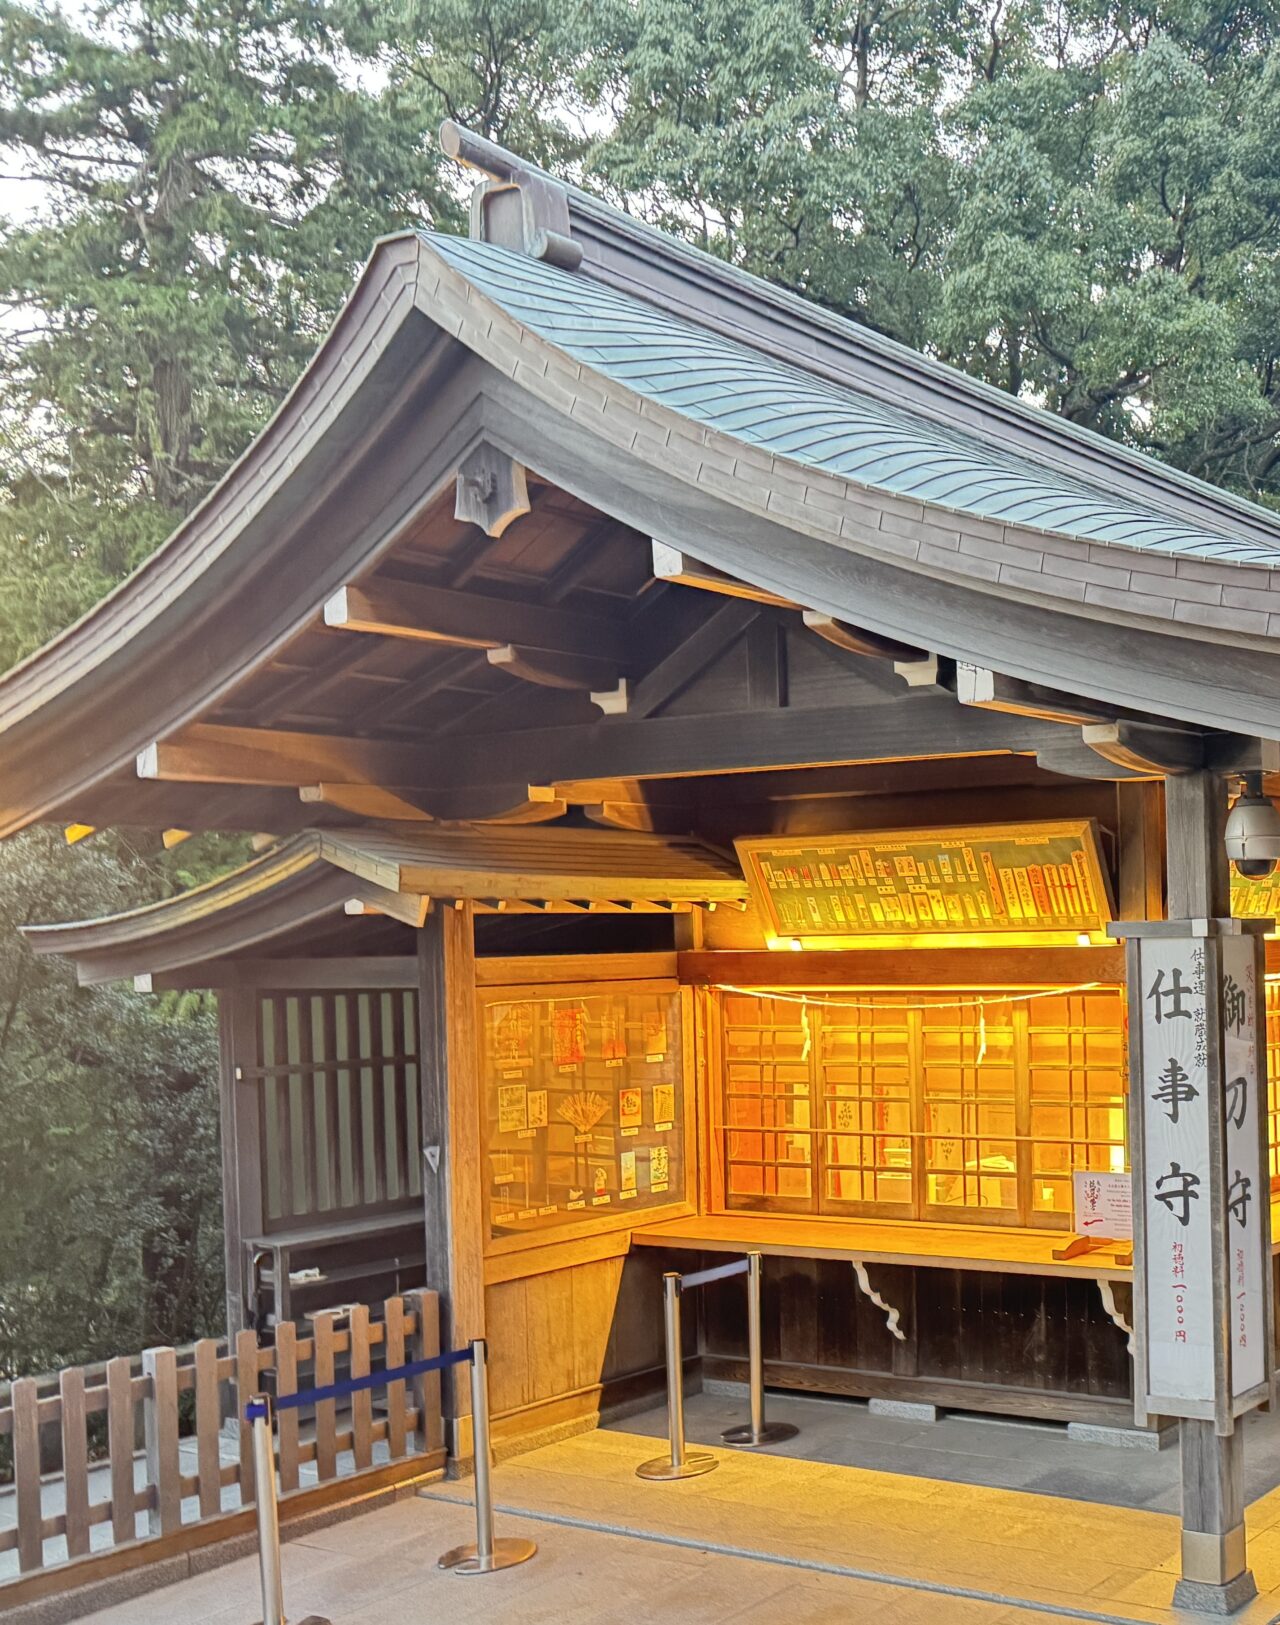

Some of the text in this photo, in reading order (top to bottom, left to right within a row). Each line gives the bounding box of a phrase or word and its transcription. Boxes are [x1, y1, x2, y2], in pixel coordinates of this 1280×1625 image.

[1146, 967, 1201, 1227] 仕事守
[1223, 974, 1252, 1228] 御刀守
